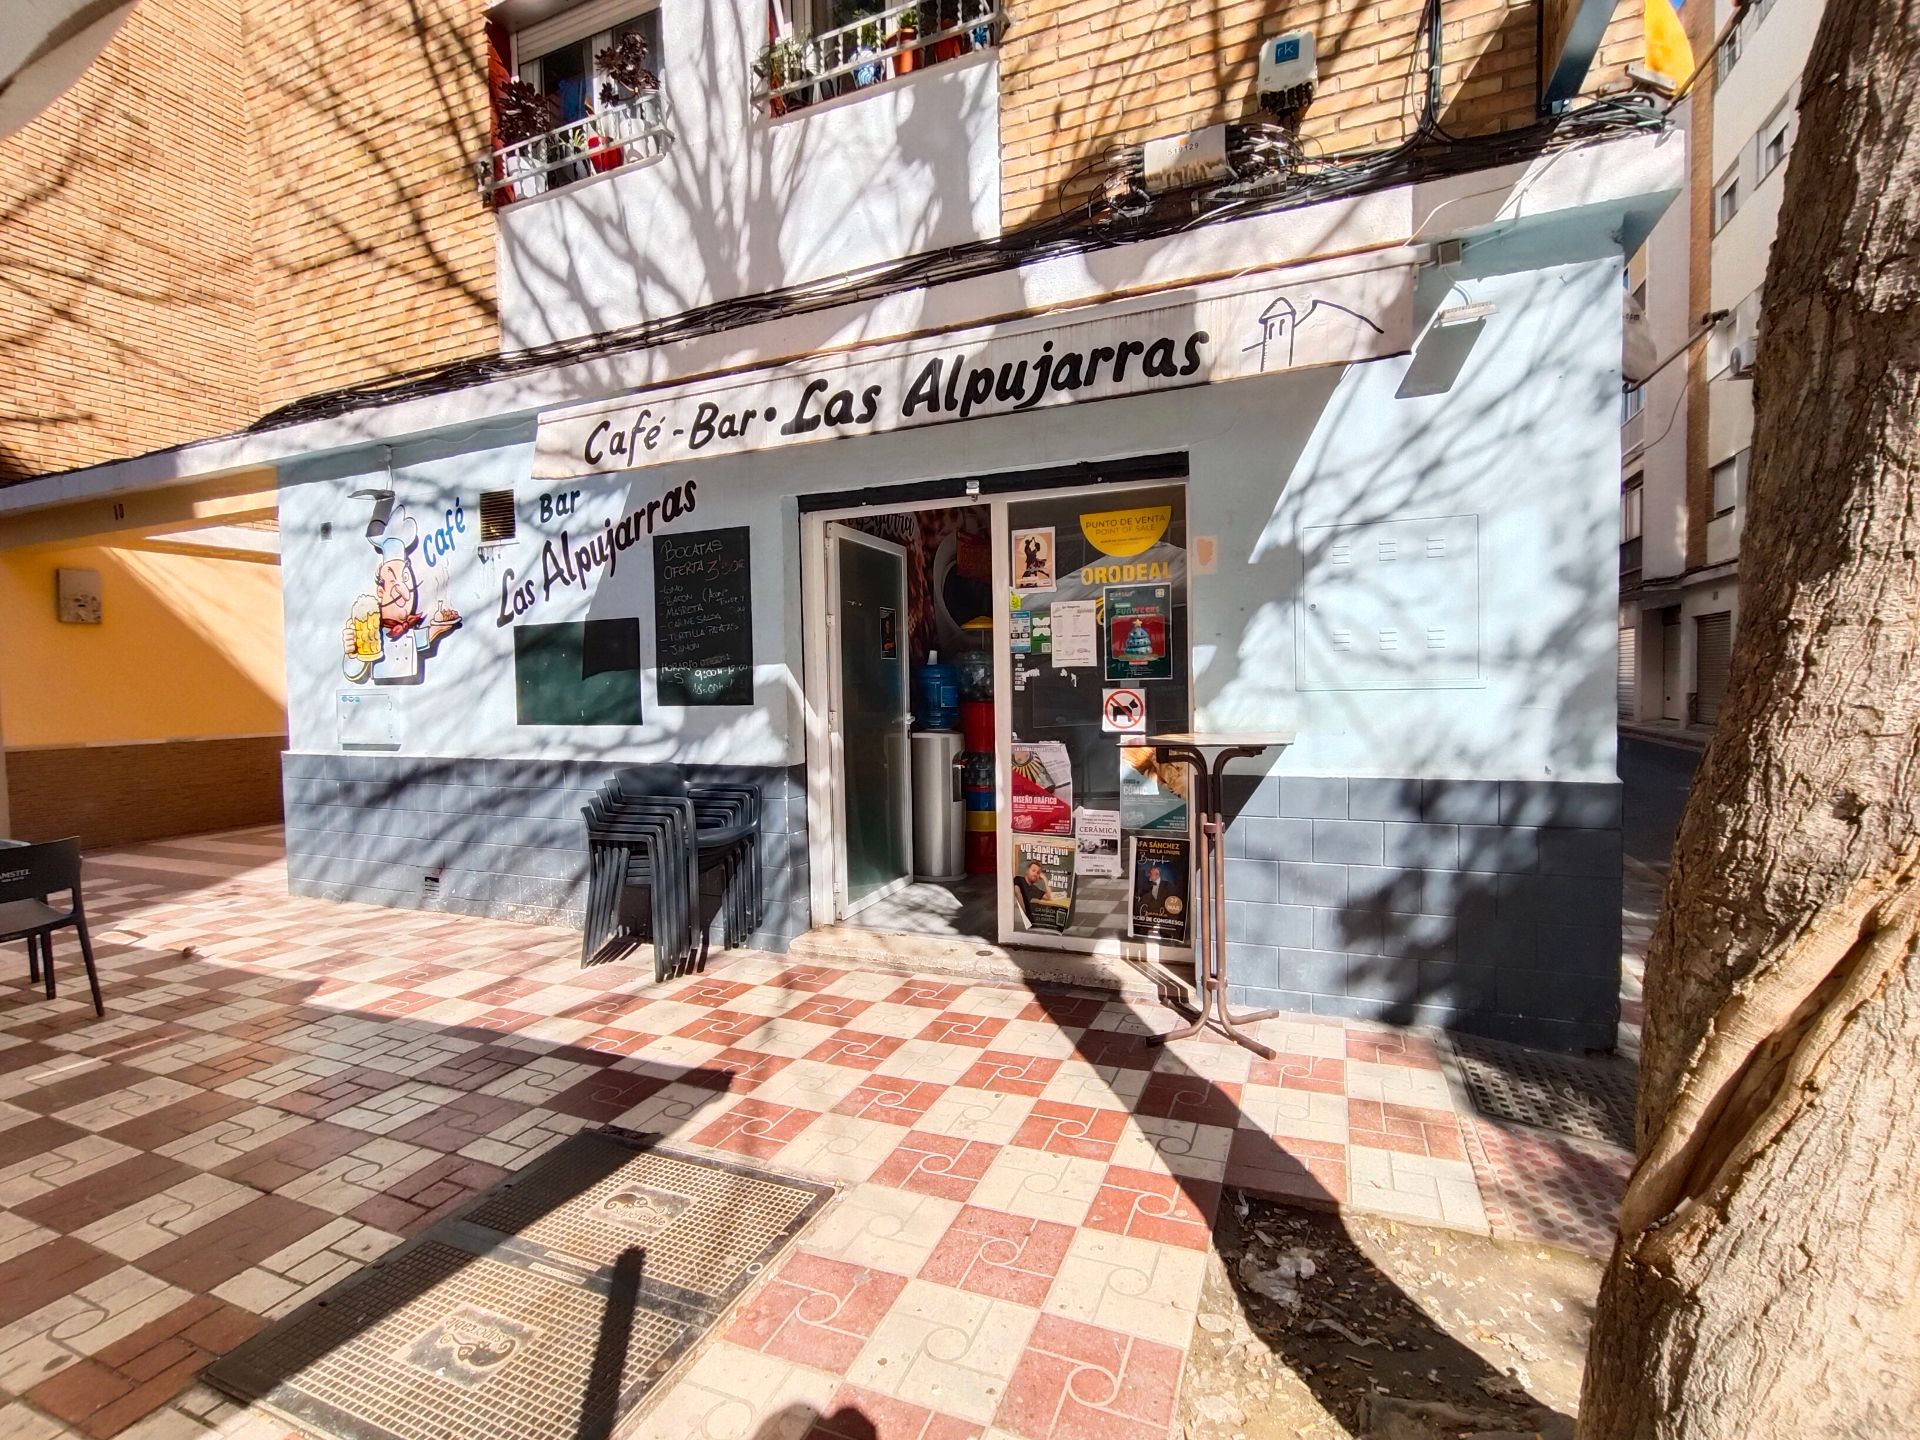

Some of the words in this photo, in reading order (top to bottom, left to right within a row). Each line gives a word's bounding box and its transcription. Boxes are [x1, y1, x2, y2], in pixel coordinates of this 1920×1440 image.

[780, 378, 883, 436] Las
[901, 330, 1210, 418] Alpujarras
[422, 497, 467, 569] Café
[538, 488, 582, 524] Bar
[1085, 519, 1118, 529] PUNTO
[1120, 517, 1133, 527] DE
[1134, 514, 1166, 525] VENTA
[1095, 527, 1120, 536] POINT
[1135, 524, 1156, 532] SALE
[496, 568, 536, 629] Las
[541, 480, 698, 602] Alpujarras
[660, 539, 723, 562] BOCATAS
[663, 560, 704, 580] OFERTA
[1079, 825, 1119, 835] CERÁMICA
[1020, 843, 1031, 853] YO
[1149, 840, 1180, 850] SÁNCHEZ
